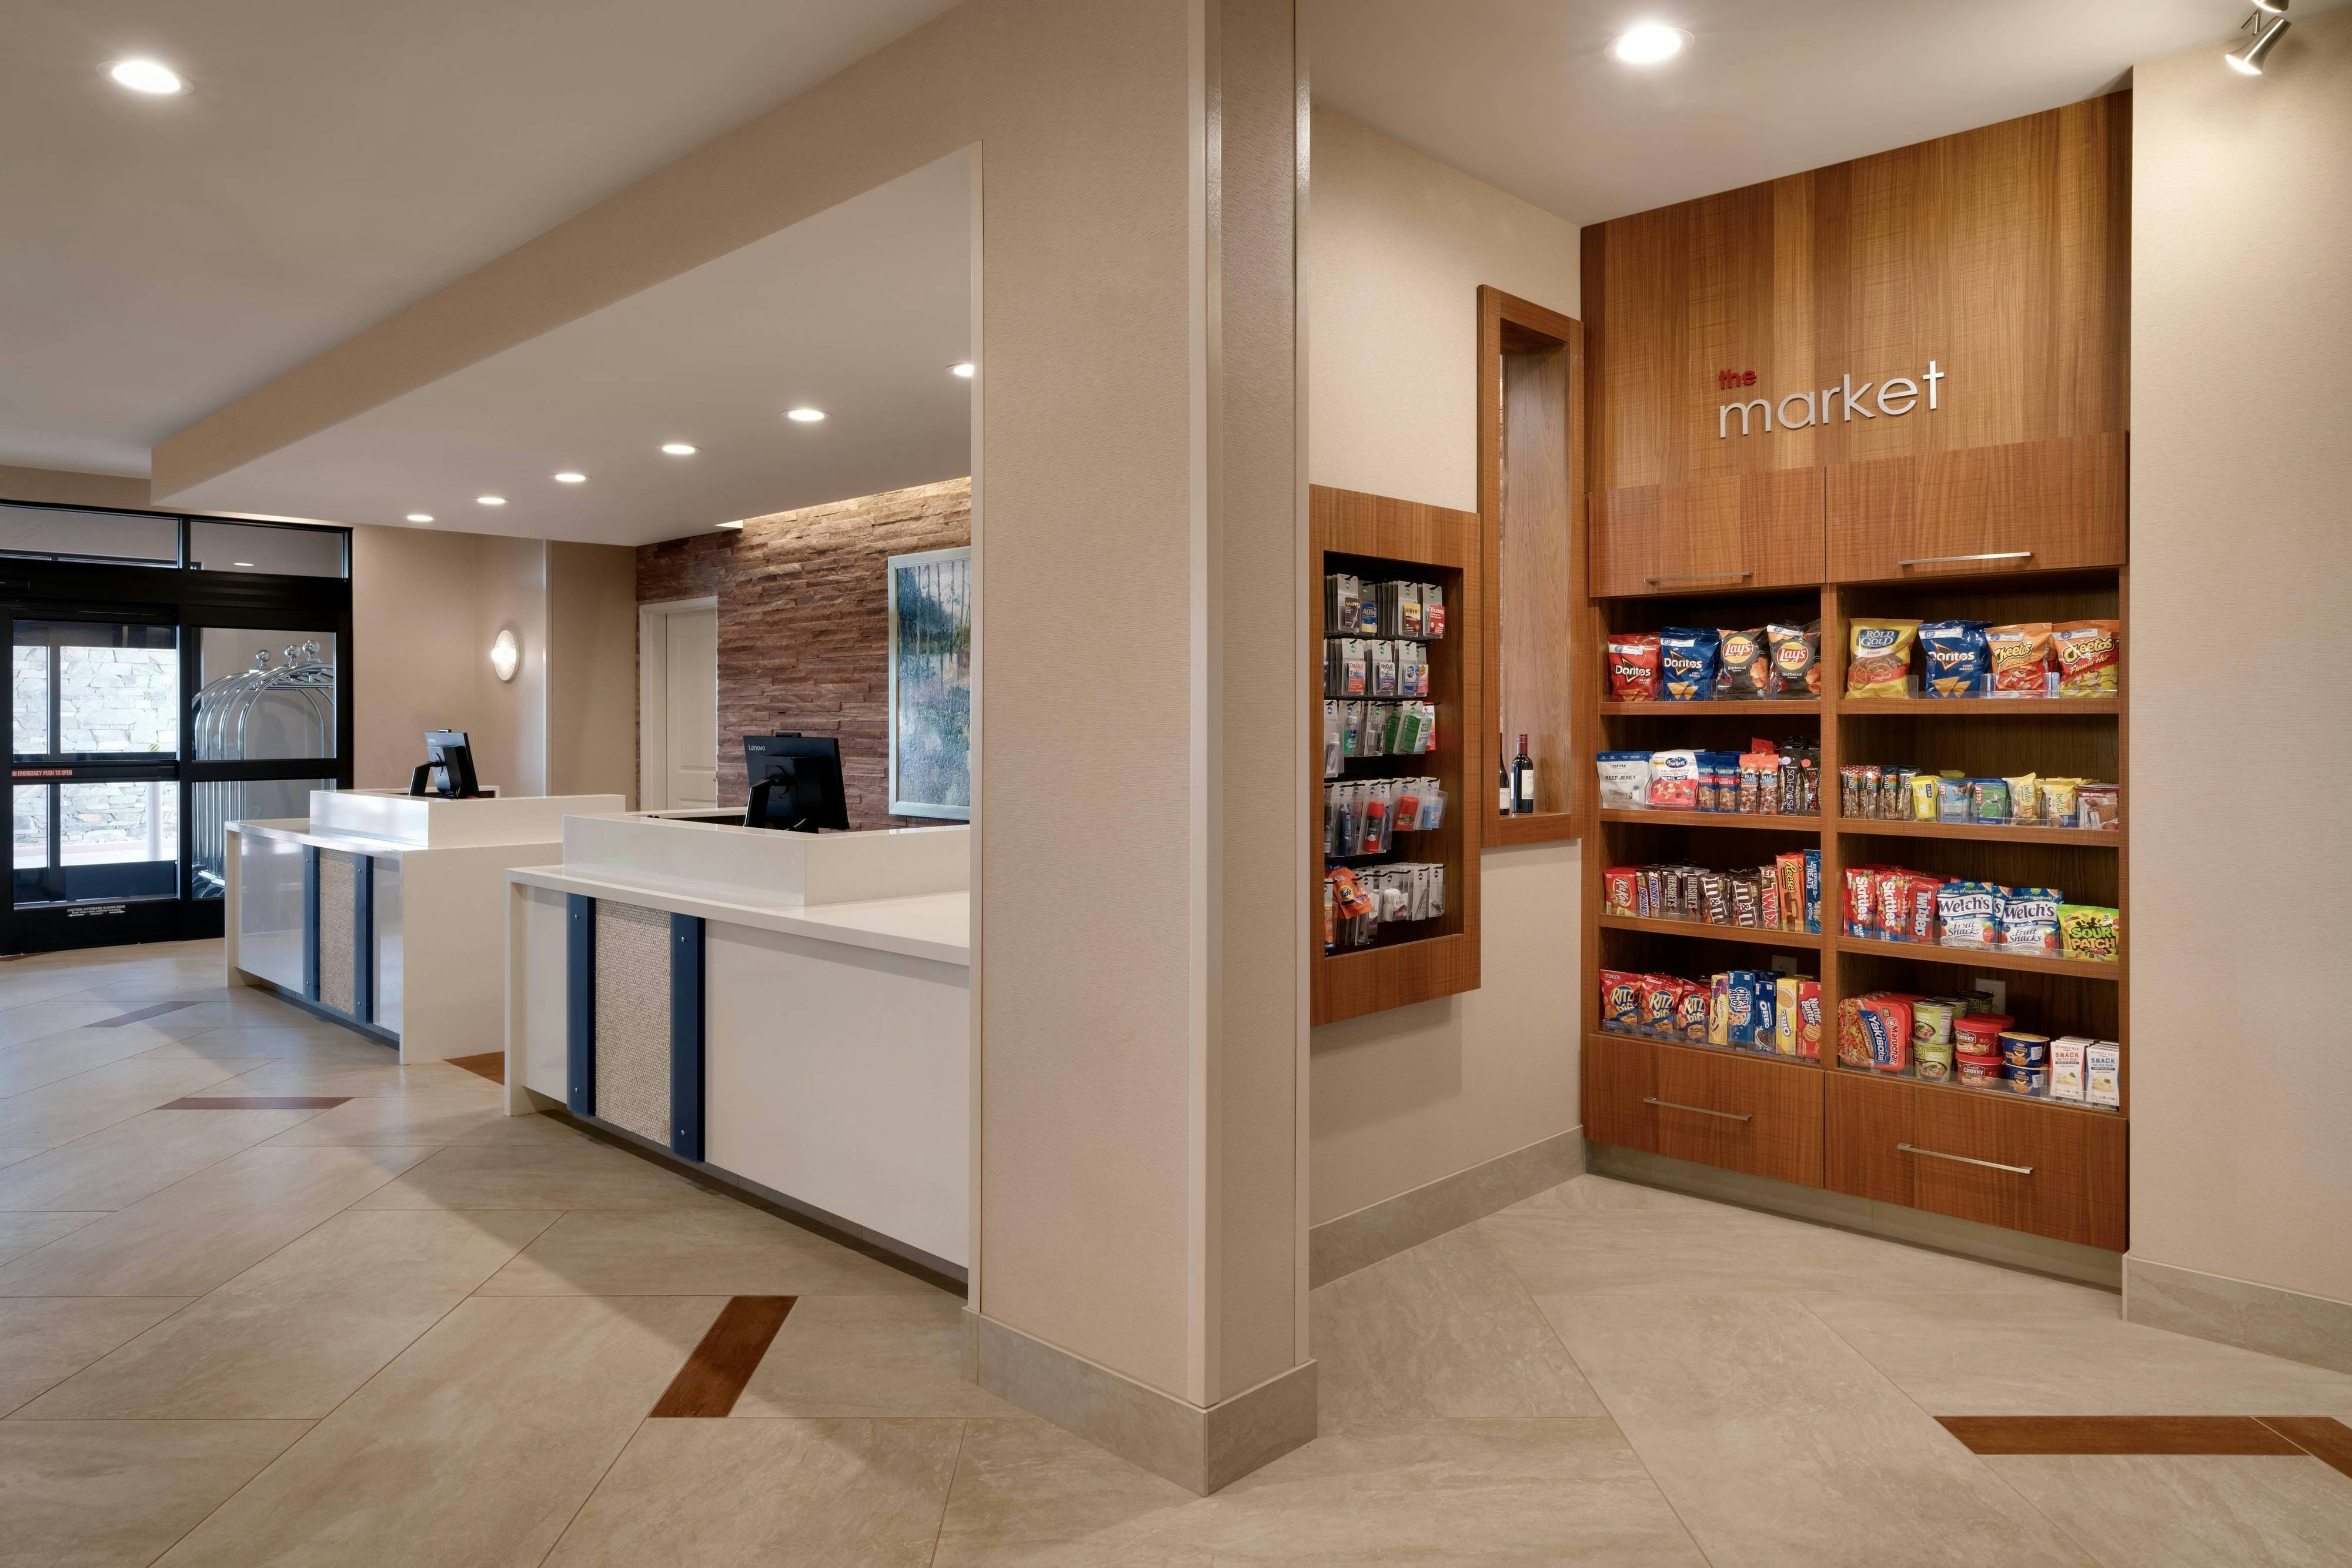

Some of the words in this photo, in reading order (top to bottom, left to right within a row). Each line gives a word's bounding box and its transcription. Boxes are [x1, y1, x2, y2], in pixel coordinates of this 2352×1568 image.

[1719, 369, 1757, 389] the
[1720, 360, 1945, 439] market
[1860, 637, 1895, 646] GOLD
[1866, 630, 1895, 638] ROLD
[1725, 643, 1751, 657] Lay's
[1779, 647, 1806, 663] Lay's
[1928, 651, 1975, 661] Doritos
[1994, 642, 2033, 665] Cheetos
[2063, 637, 2113, 663] Cheetos
[1664, 657, 1703, 668] Doritos
[2096, 654, 2110, 663] Hot
[1615, 665, 1651, 676] Doritos
[1870, 673, 1892, 681] Original
[1786, 770, 1795, 810] PISTACHIOS
[1809, 771, 1817, 811] PISTACHIOS
[1785, 861, 1798, 894] Reese's
[1340, 888, 1352, 900] Tide
[1649, 878, 1659, 907] SNICKERS
[1855, 877, 1870, 921] Skittles
[1762, 882, 1778, 929] TWIX
[1882, 881, 1897, 927] Skittles
[1939, 897, 1990, 912] Welch's
[2005, 904, 2054, 919] Welch's
[1915, 891, 1932, 936] Twizzlers
[1948, 927, 1980, 936] Snacks
[1954, 921, 1976, 930] Fruit
[2072, 927, 2112, 938] SOUR
[2009, 935, 2042, 944] Snacks
[2070, 938, 2116, 950] PATCH
[1612, 988, 1634, 1004] RITZ
[1649, 992, 1673, 1009] RITZ
[1736, 987, 1748, 1007] Chips
[1616, 1002, 1635, 1012] bits
[1653, 1009, 1669, 1018] bits
[1683, 997, 1703, 1014] RITZ
[1801, 1000, 1816, 1025] Butter
[1809, 997, 1821, 1023] Nutter
[1687, 1012, 1705, 1022] bits
[1759, 1000, 1770, 1028] OREO
[1781, 1009, 1791, 1037] OREO
[1867, 1015, 1887, 1061] Yakisoba
[1891, 1026, 1899, 1064] Maruchan
